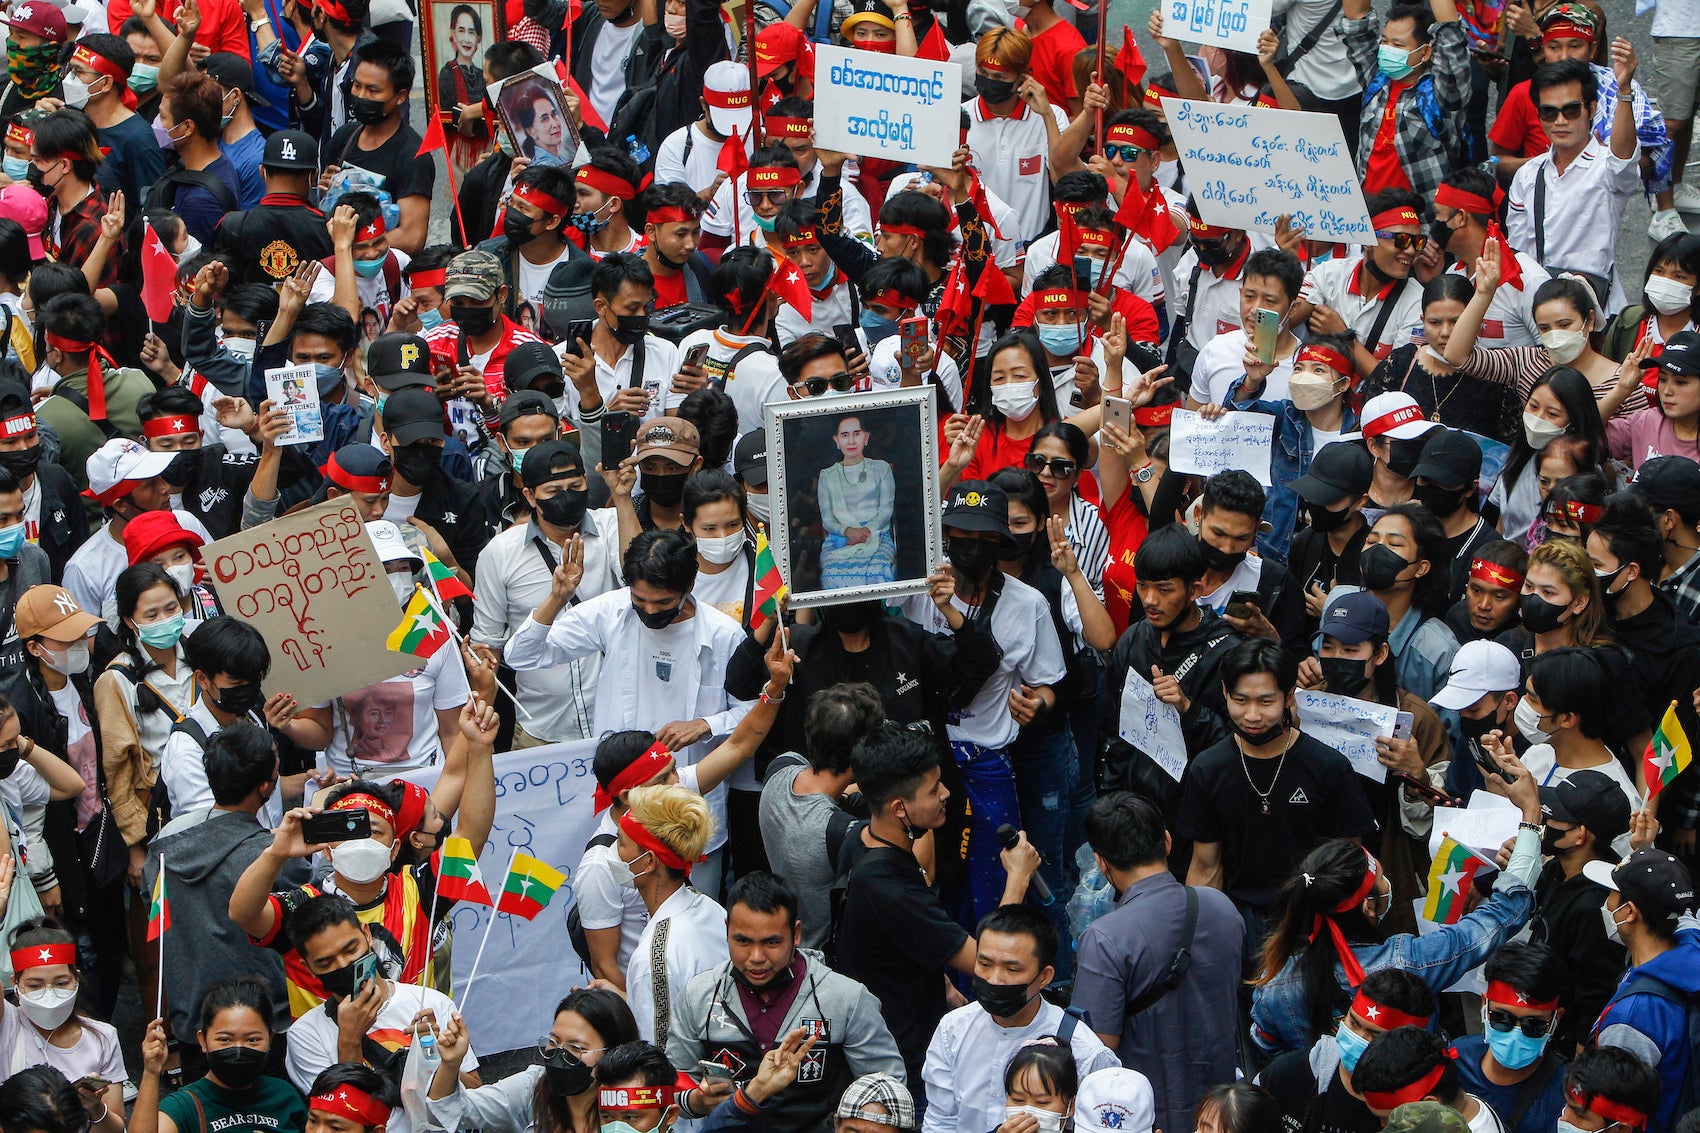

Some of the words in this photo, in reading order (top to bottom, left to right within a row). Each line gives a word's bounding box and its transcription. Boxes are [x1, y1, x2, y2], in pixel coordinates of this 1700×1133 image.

[727, 96, 748, 105] NUG
[786, 124, 808, 132] NUG
[1113, 127, 1134, 136] NUG
[281, 138, 297, 160] LA
[756, 172, 779, 181] NUG
[1083, 233, 1104, 242] NUG
[1044, 294, 1067, 303] NUG
[401, 344, 419, 370] P
[271, 373, 283, 382] SET
[283, 371, 295, 380] HER
[294, 402, 317, 413] SCIENCE
[1392, 407, 1413, 423] NUG
[5, 416, 32, 435] NUG
[198, 486, 217, 505] NIKE
[54, 591, 78, 616] NY
[600, 1089, 628, 1107] NUG
[210, 1115, 246, 1132] BEAR
[247, 1114, 279, 1129] SLEEP
